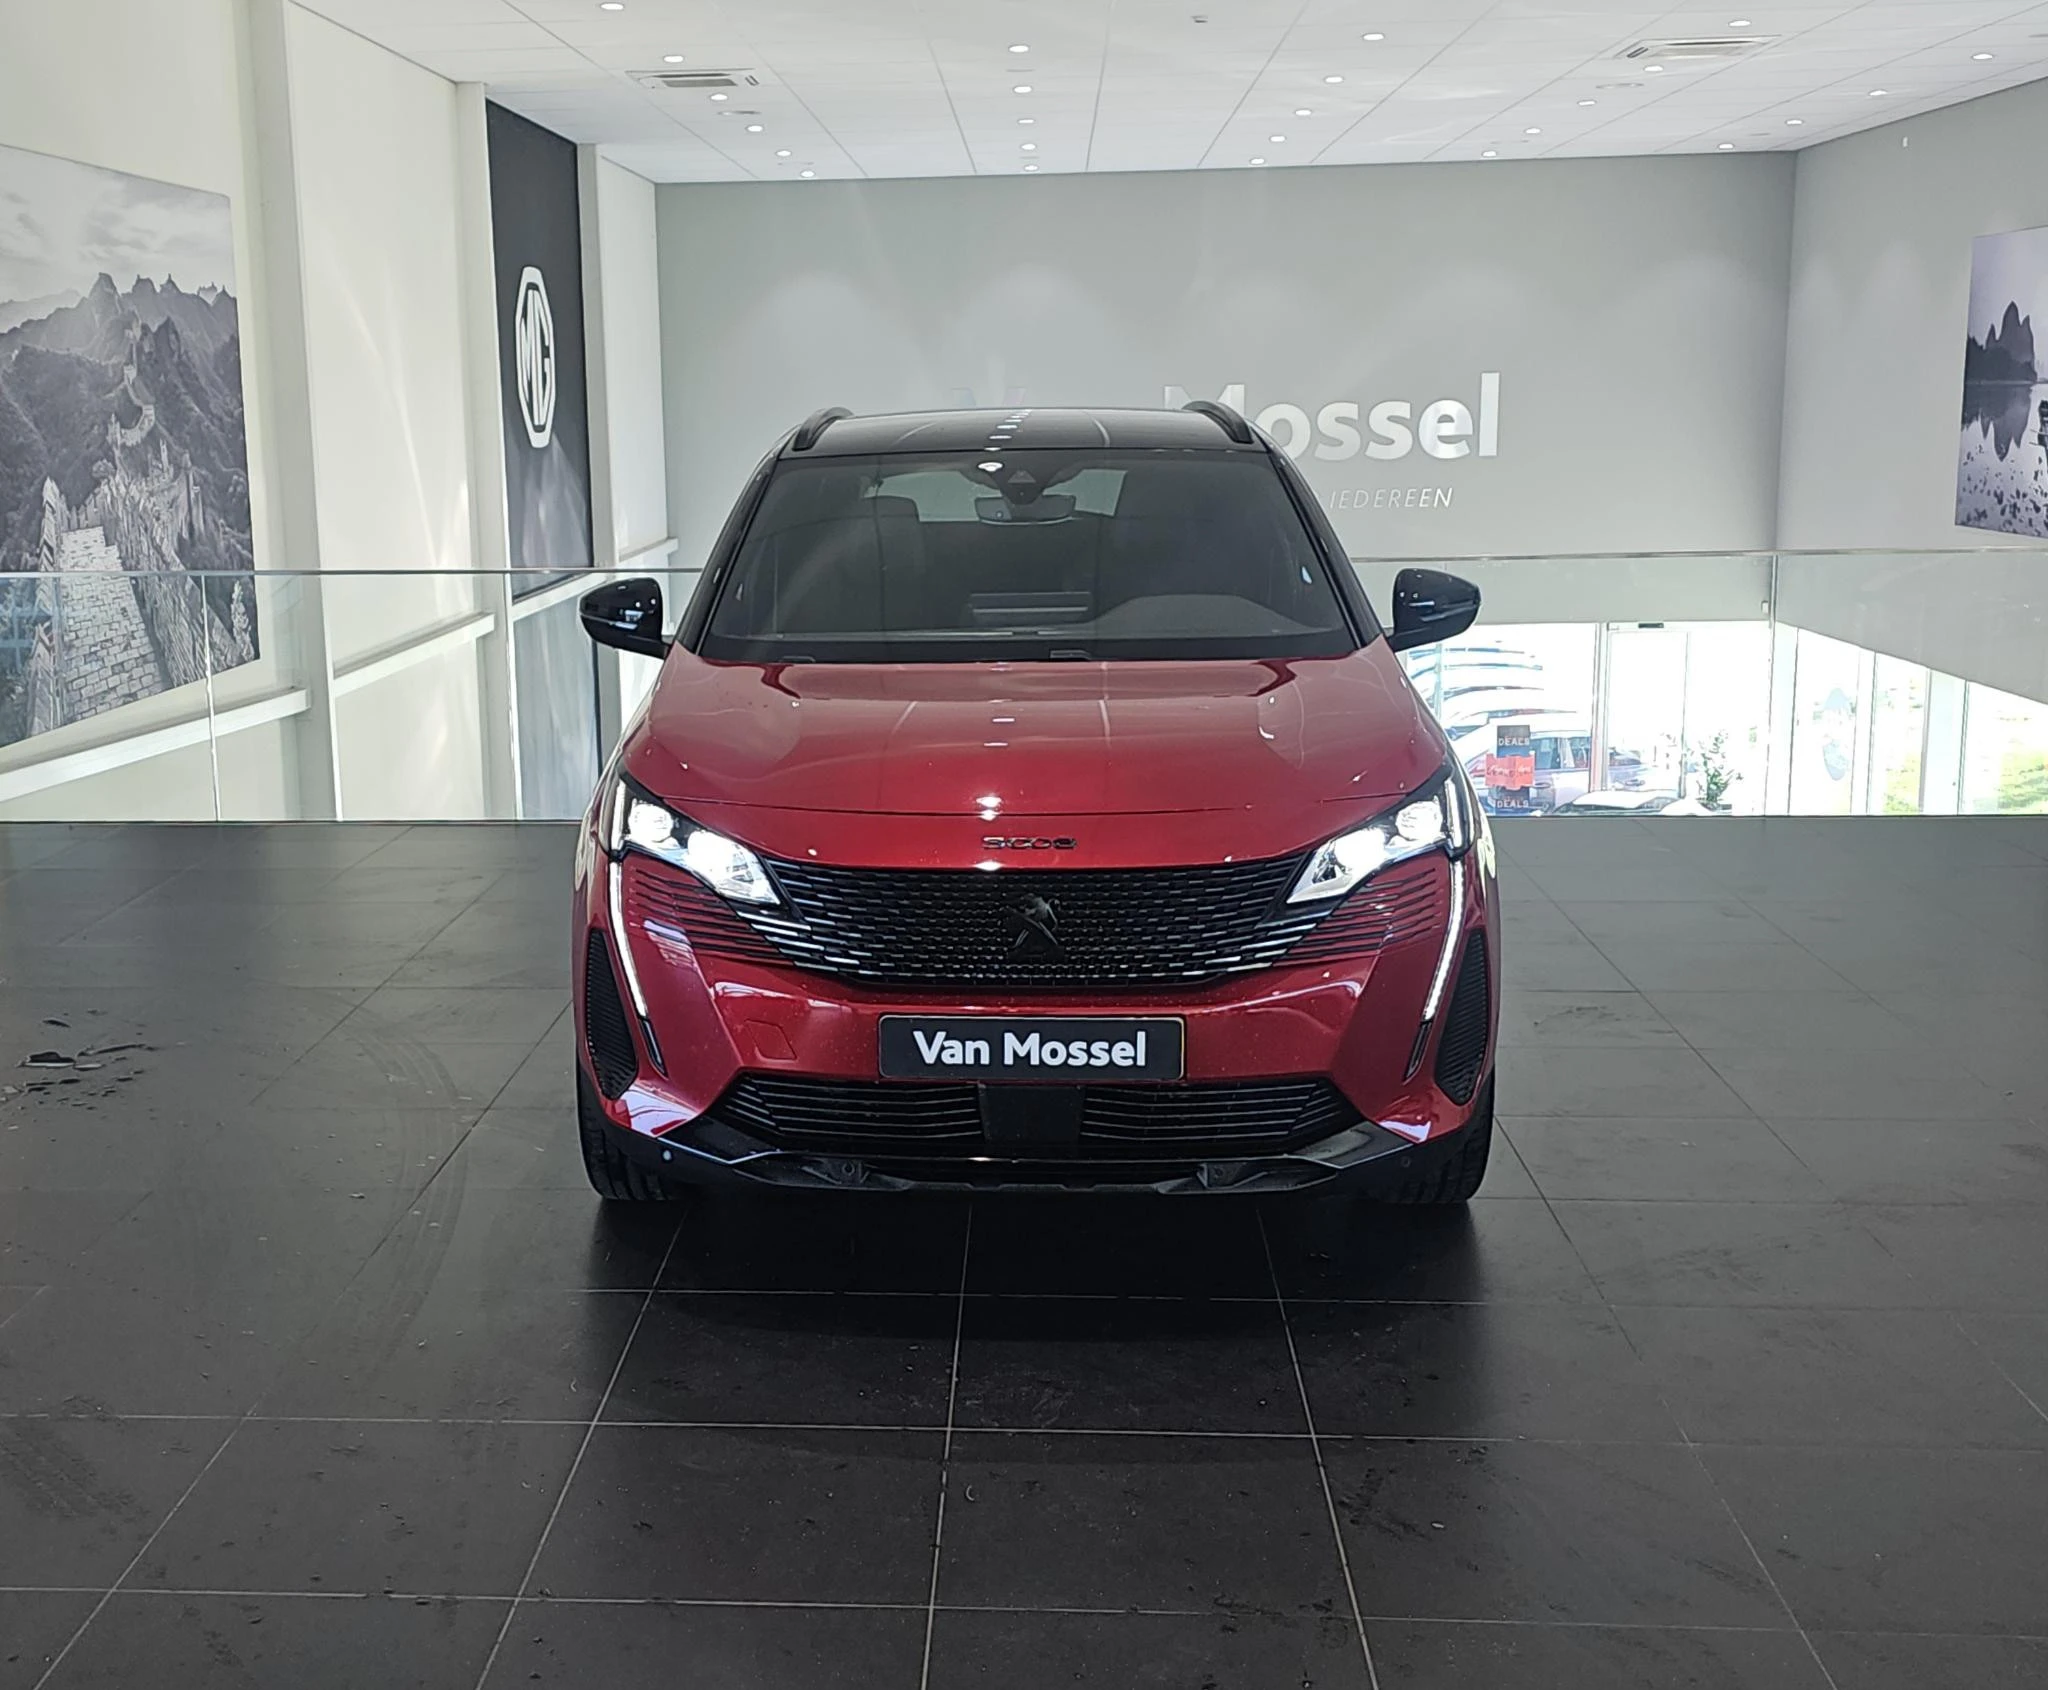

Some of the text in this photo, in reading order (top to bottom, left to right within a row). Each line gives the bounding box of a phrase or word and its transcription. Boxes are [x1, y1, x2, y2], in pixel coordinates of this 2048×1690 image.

[520, 288, 551, 426] MG
[1329, 487, 1453, 509] IEDEREEN
[1498, 737, 1530, 746] DEALS
[1496, 799, 1529, 808] DEALS
[912, 1030, 1147, 1067] Van Mossel
